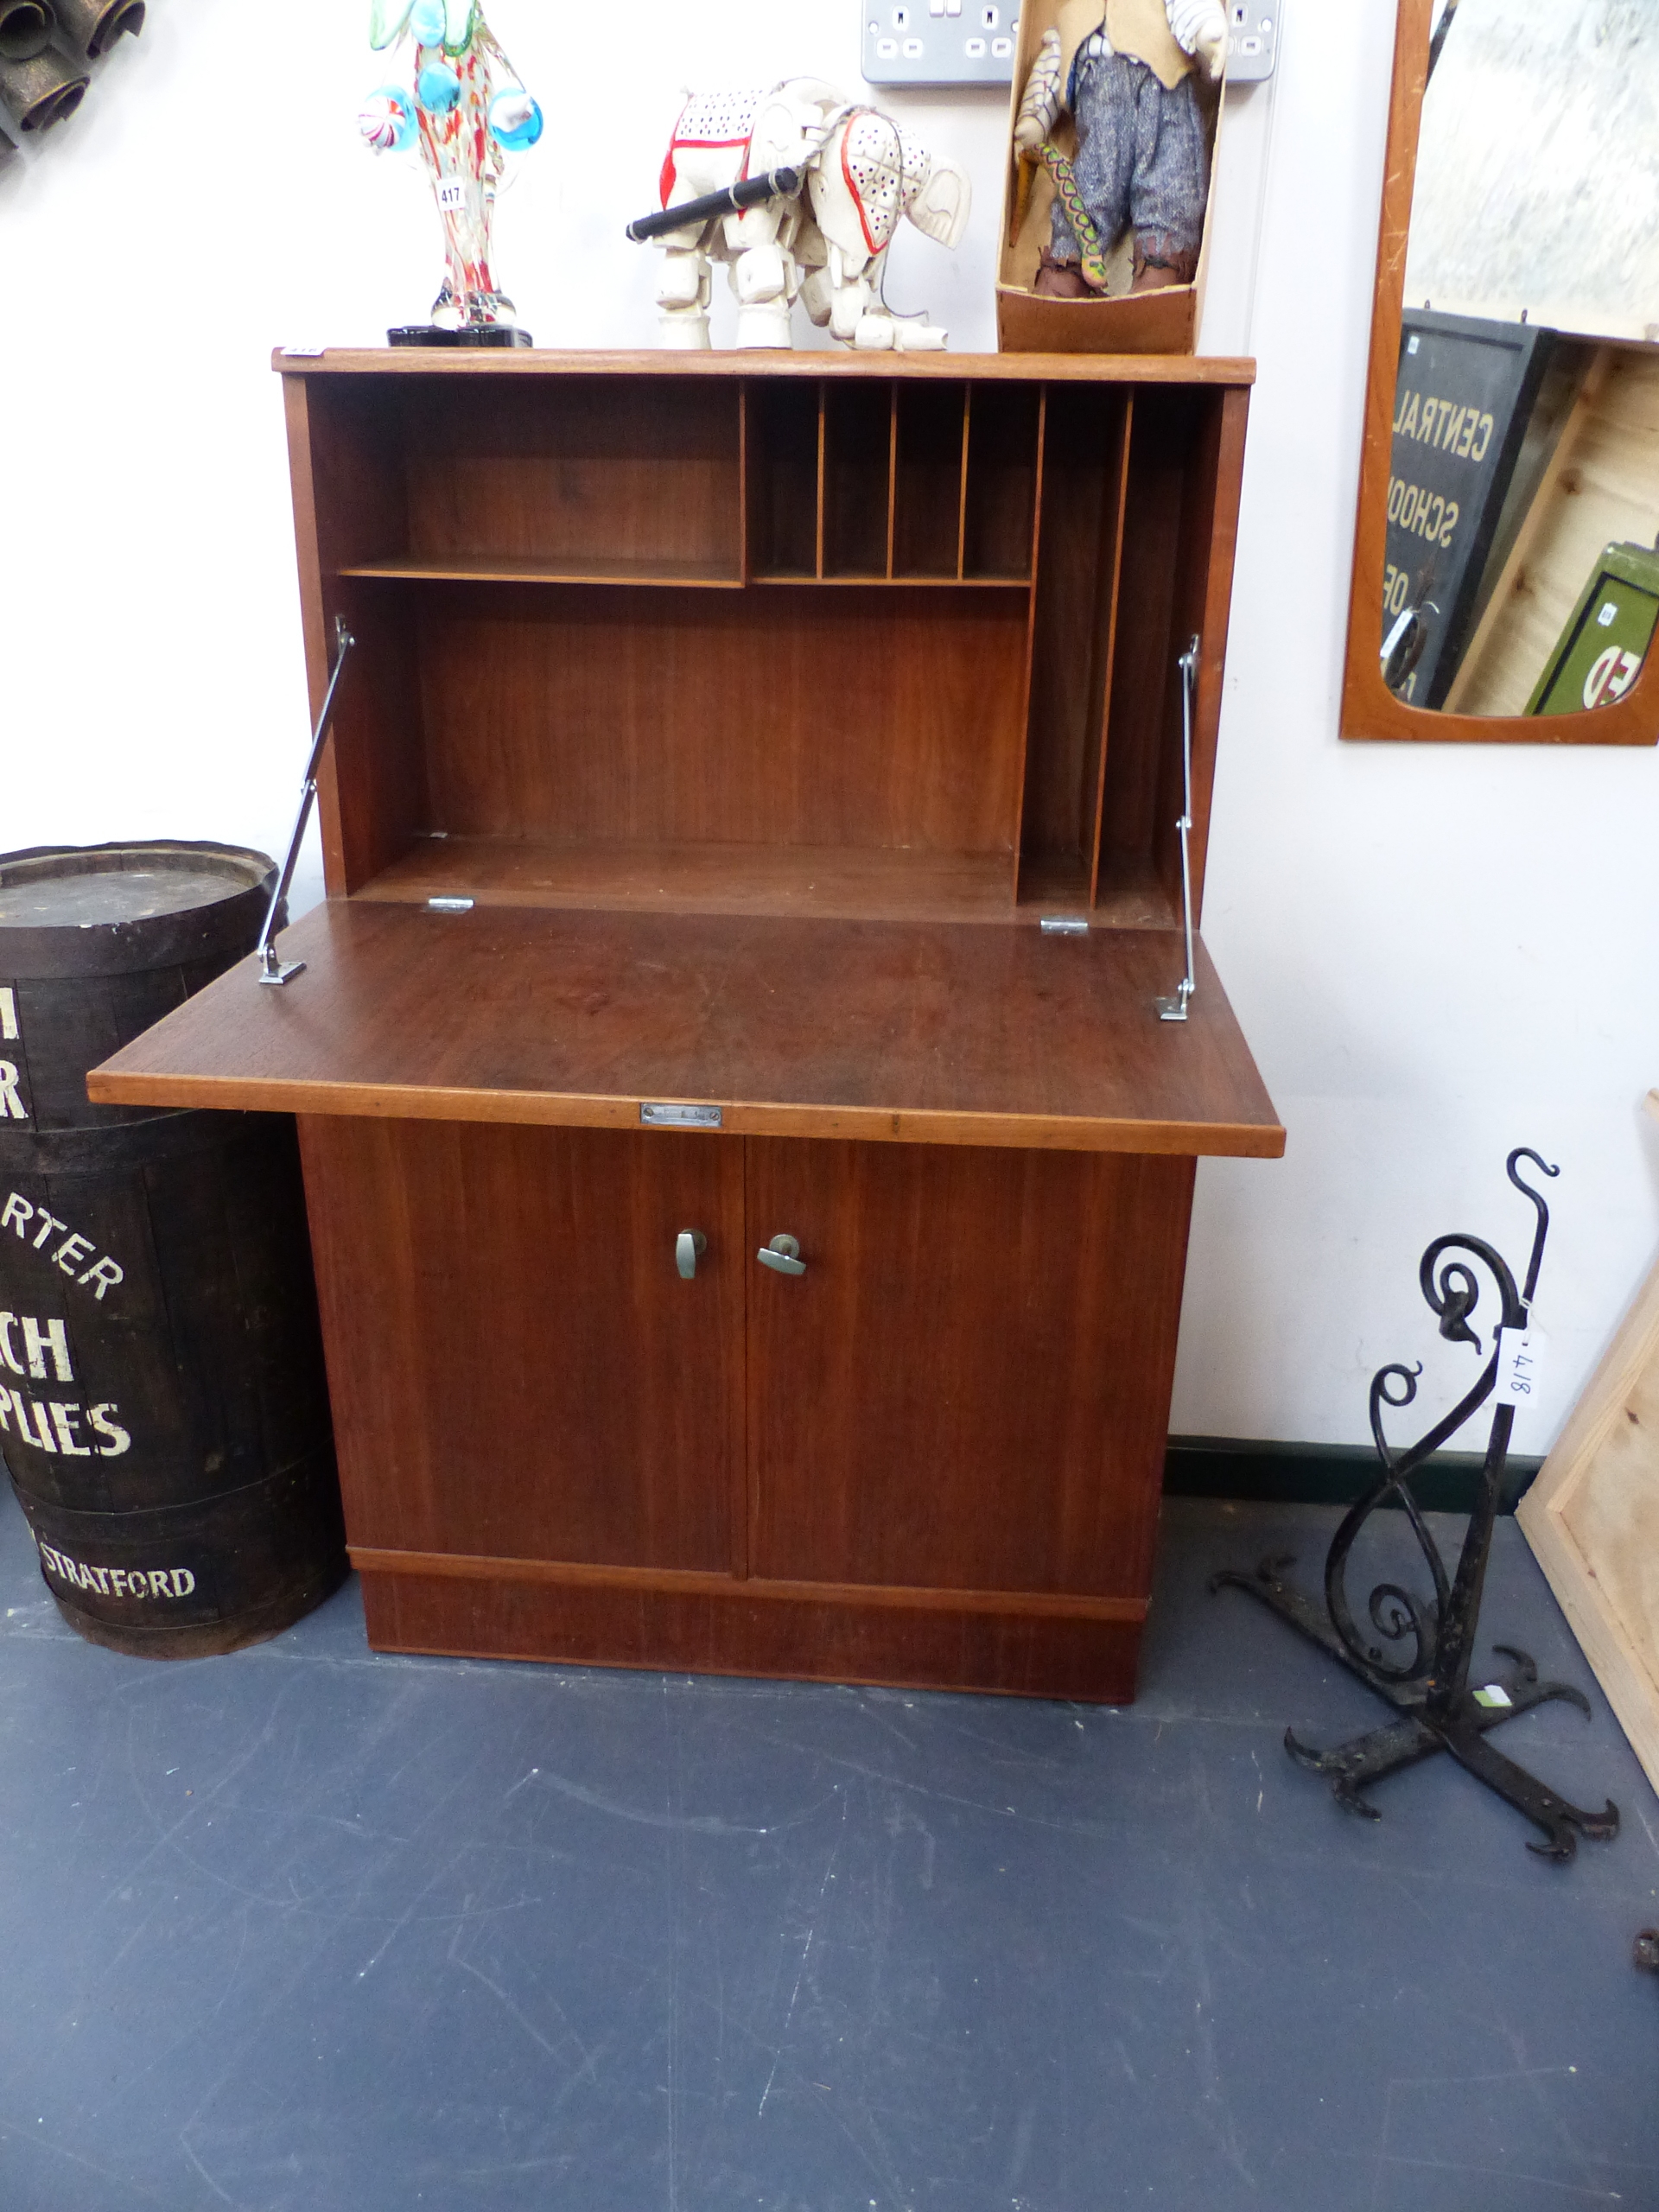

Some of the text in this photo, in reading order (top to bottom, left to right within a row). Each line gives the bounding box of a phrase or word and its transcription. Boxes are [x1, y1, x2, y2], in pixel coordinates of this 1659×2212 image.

[442, 187, 460, 204] 417
[0, 1312, 74, 1382] CH
[1510, 1354, 1534, 1395] 418
[40, 1541, 196, 1599] STRATFORD
